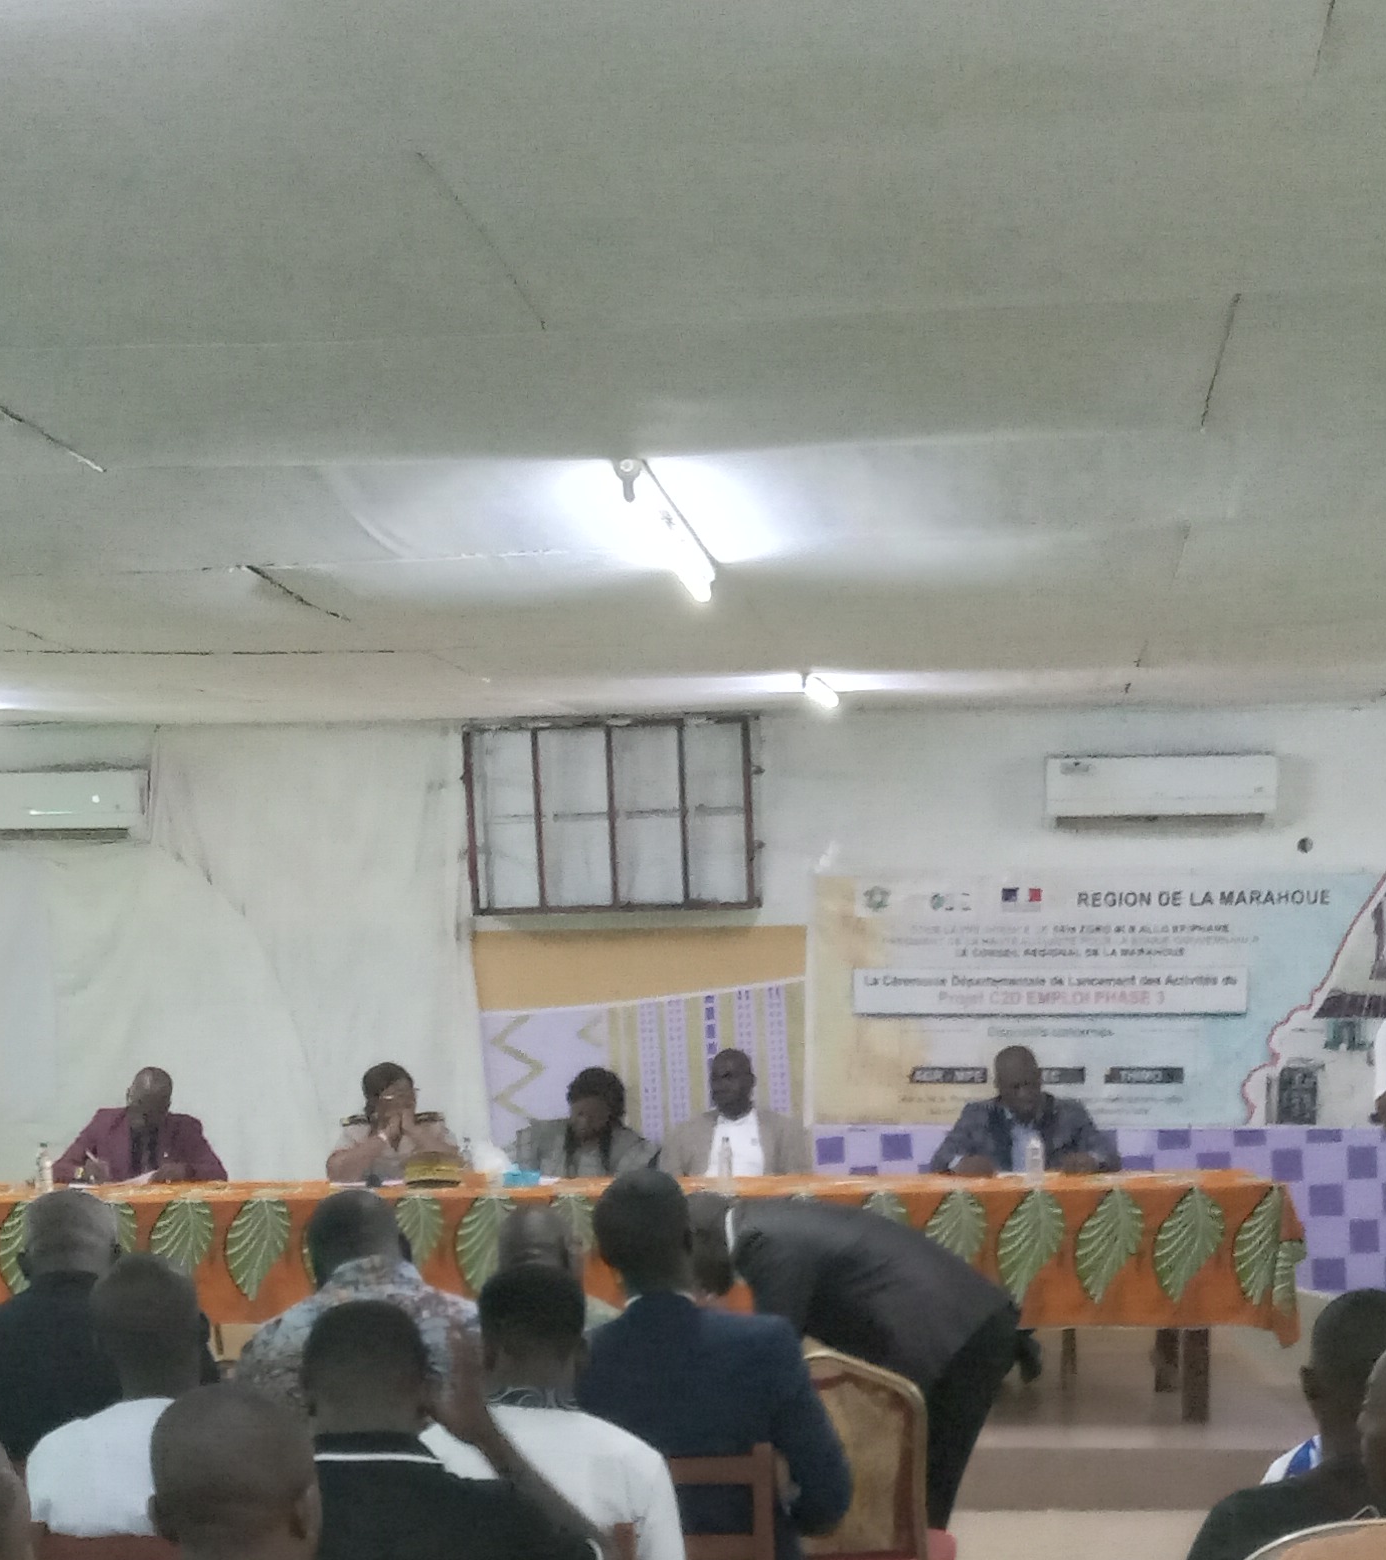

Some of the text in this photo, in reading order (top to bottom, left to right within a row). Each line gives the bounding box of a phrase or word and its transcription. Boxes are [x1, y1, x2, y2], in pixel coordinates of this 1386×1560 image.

[1076, 888, 1332, 908] REGION DE LA MARAHOUE
[1093, 990, 1151, 1006] PHASE
